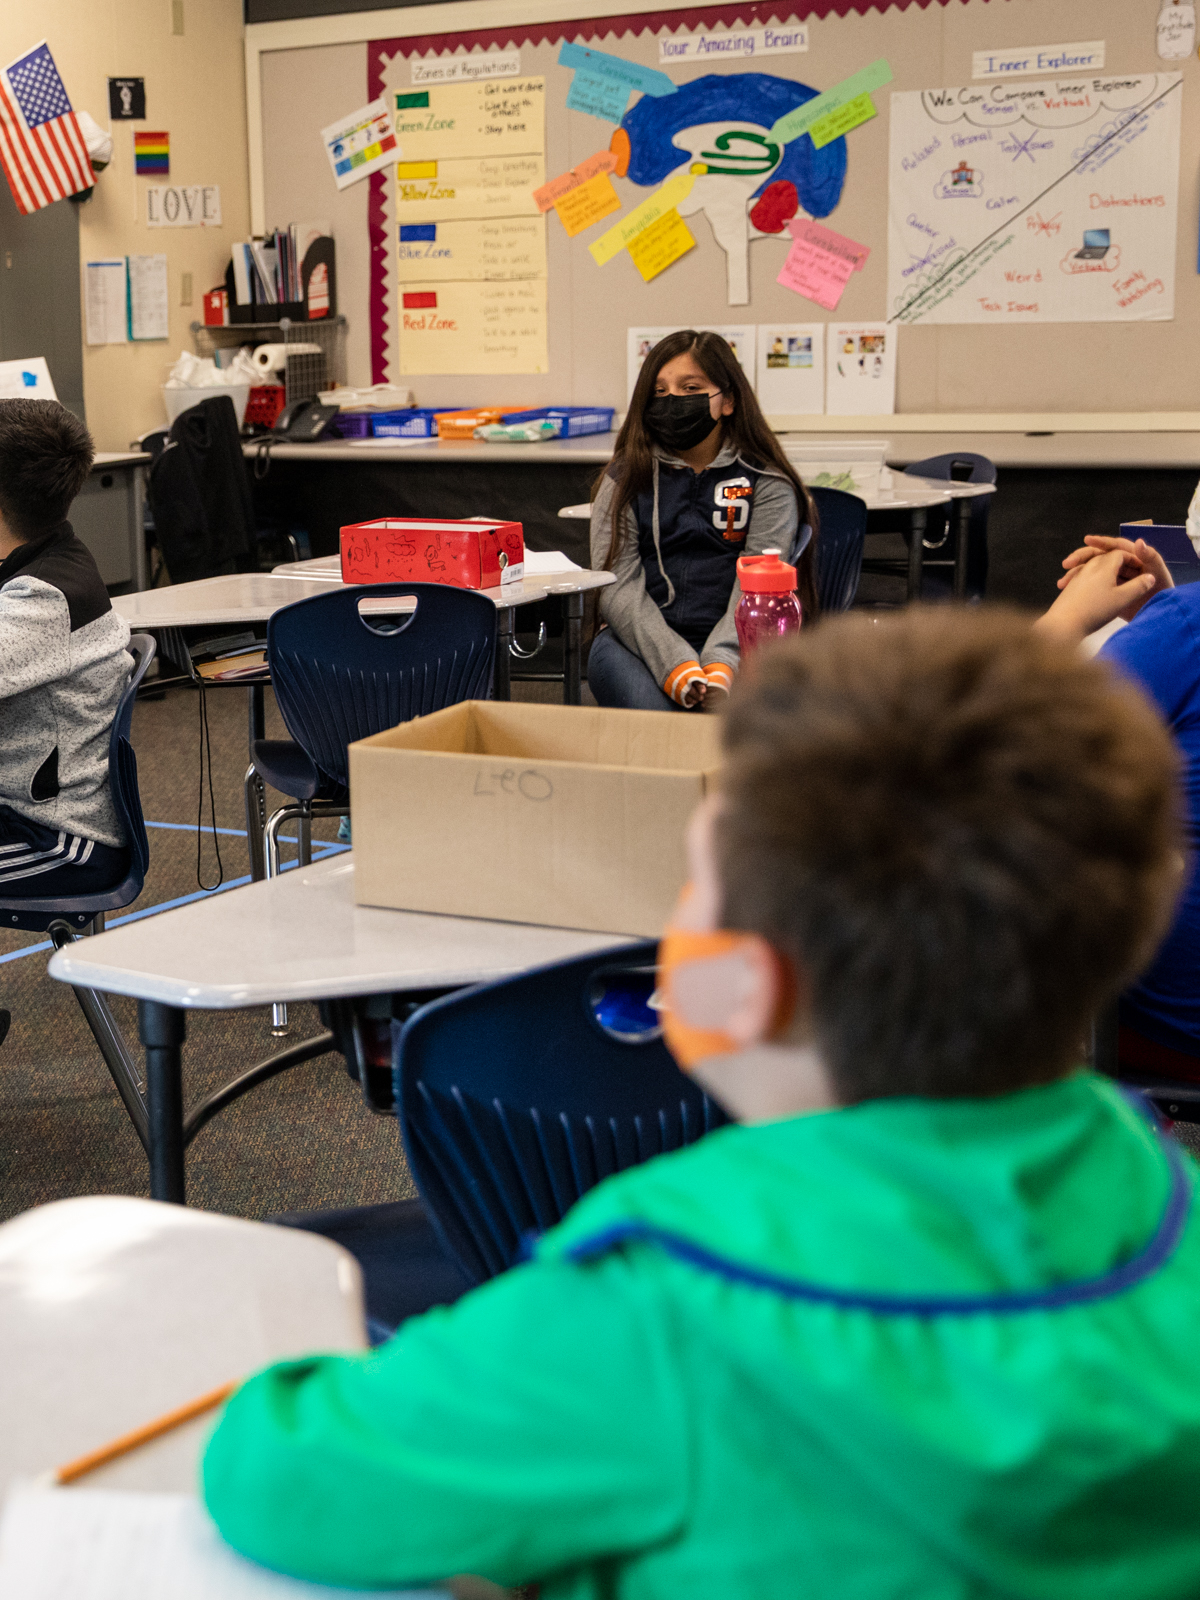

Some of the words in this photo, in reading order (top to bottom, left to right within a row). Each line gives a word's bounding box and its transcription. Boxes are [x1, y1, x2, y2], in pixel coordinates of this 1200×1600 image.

[661, 40, 689, 56] Your
[696, 32, 755, 55] Amazing
[764, 29, 805, 47] Brain
[414, 65, 444, 81] Zones
[446, 66, 456, 77] of
[461, 60, 518, 80] Regulations
[983, 57, 1030, 73] Inner
[1037, 52, 1095, 70] Explorer
[928, 91, 953, 107] We
[957, 87, 983, 104] Can
[990, 86, 1046, 104] Compare
[1055, 82, 1086, 96] Inner
[1092, 79, 1142, 96] Explorer
[981, 103, 1019, 115] School
[1044, 97, 1091, 110] Virtual
[395, 113, 424, 134] Green
[425, 112, 456, 132] Zone
[399, 184, 428, 201] Yellow
[429, 182, 456, 199] Zone
[1089, 193, 1166, 210] Distractions
[148, 187, 215, 222] LOVE
[399, 246, 422, 260] Blue
[423, 244, 453, 259] Zone
[403, 313, 425, 331] Red
[427, 313, 458, 331] Zone
